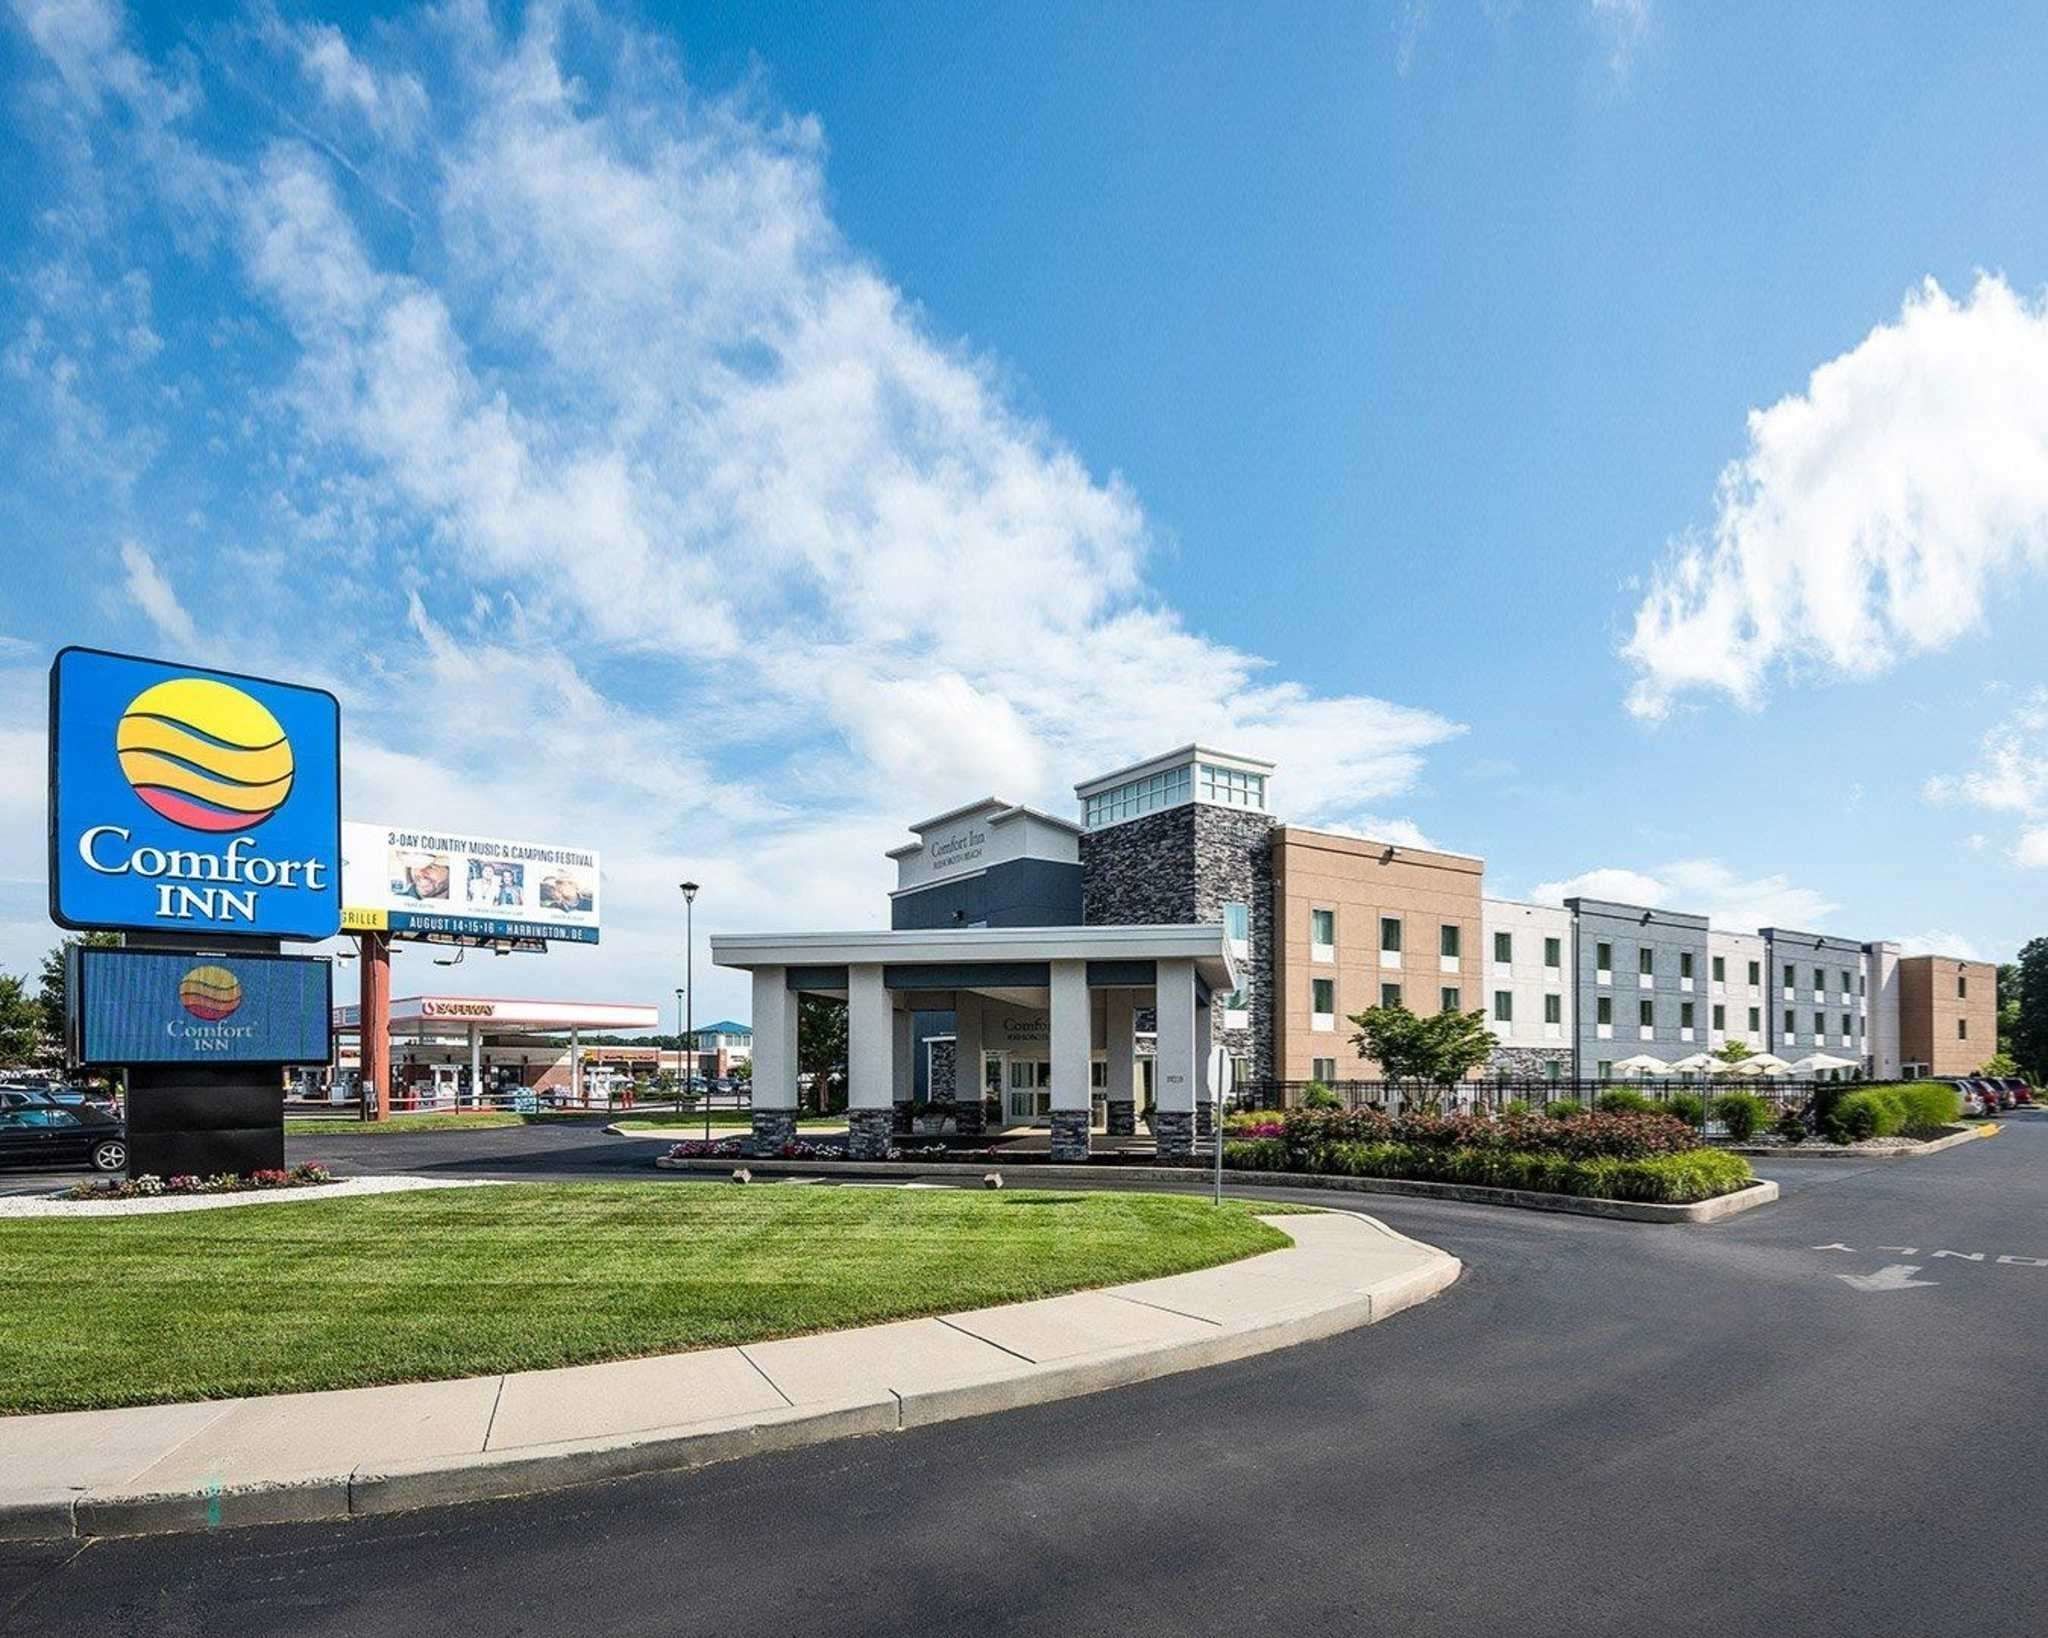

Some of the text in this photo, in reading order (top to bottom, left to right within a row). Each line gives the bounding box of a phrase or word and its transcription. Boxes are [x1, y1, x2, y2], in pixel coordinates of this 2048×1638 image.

[388, 832, 594, 868] 3-DAY COUNTRY MUSIC & CAMPING FESTIVAL
[931, 830, 986, 858] Comfort Inn
[79, 826, 327, 891] Comfort
[155, 884, 257, 923] INN
[409, 916, 449, 932] AUGUST
[436, 1002, 496, 1017] SAFEWAY
[167, 1020, 253, 1039] Comfort
[194, 1039, 229, 1051] INN
